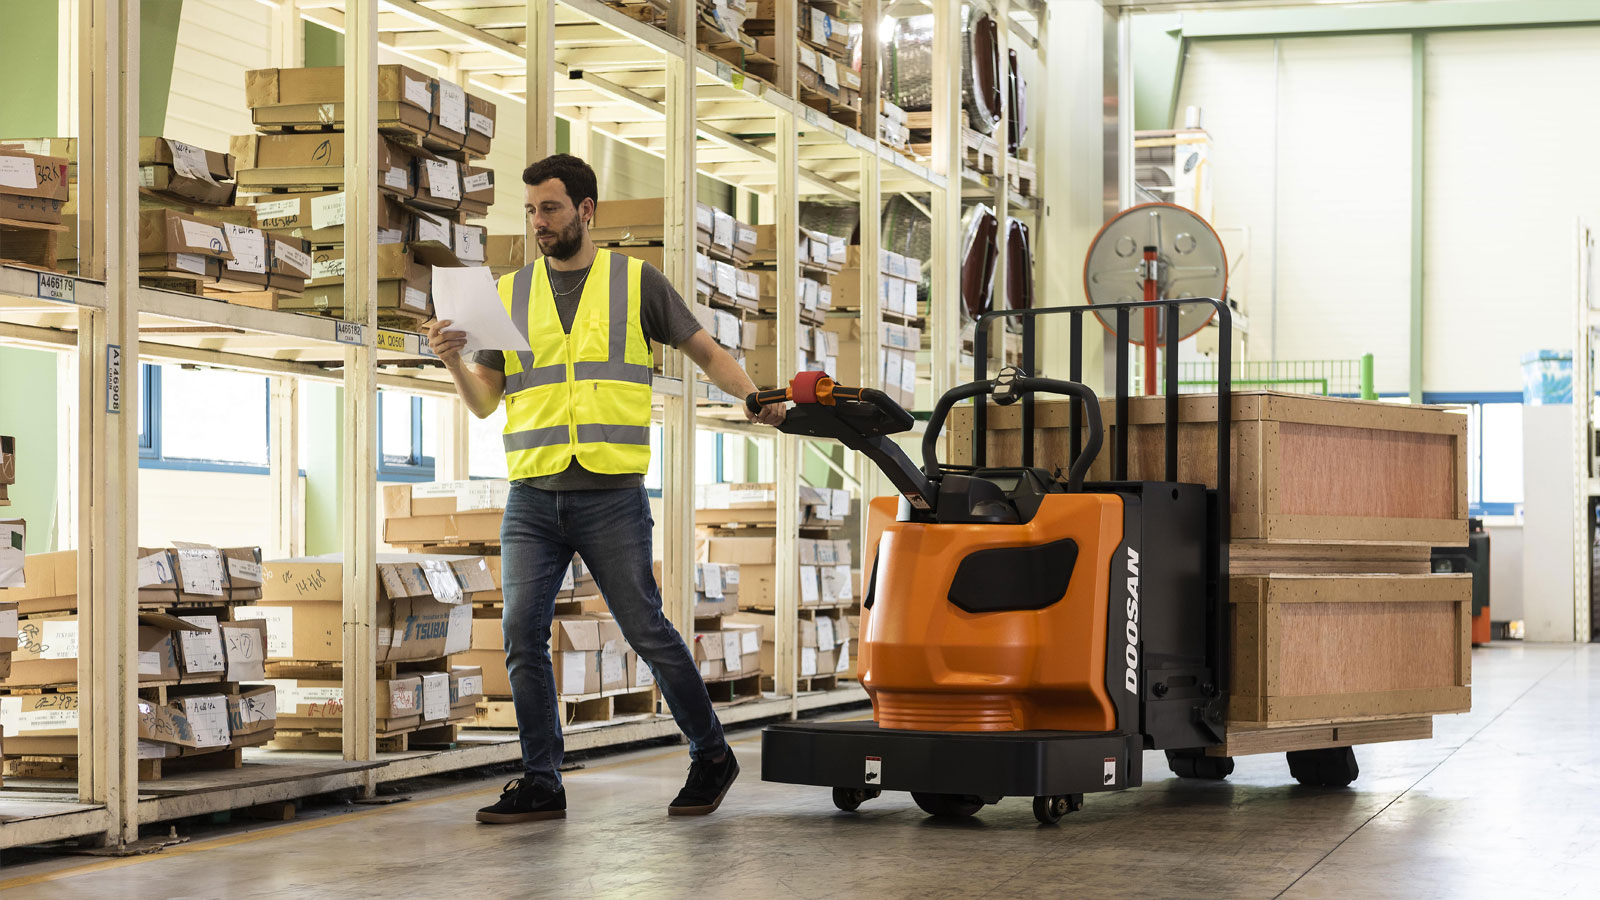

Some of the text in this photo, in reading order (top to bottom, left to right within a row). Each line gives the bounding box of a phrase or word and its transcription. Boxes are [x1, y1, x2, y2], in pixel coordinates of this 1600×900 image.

[40, 275, 73, 292] A466179
[50, 290, 63, 298] CHAIN
[112, 349, 120, 410] A146908
[1125, 546, 1140, 695] DOOSAN
[416, 621, 449, 640] TSUBA
